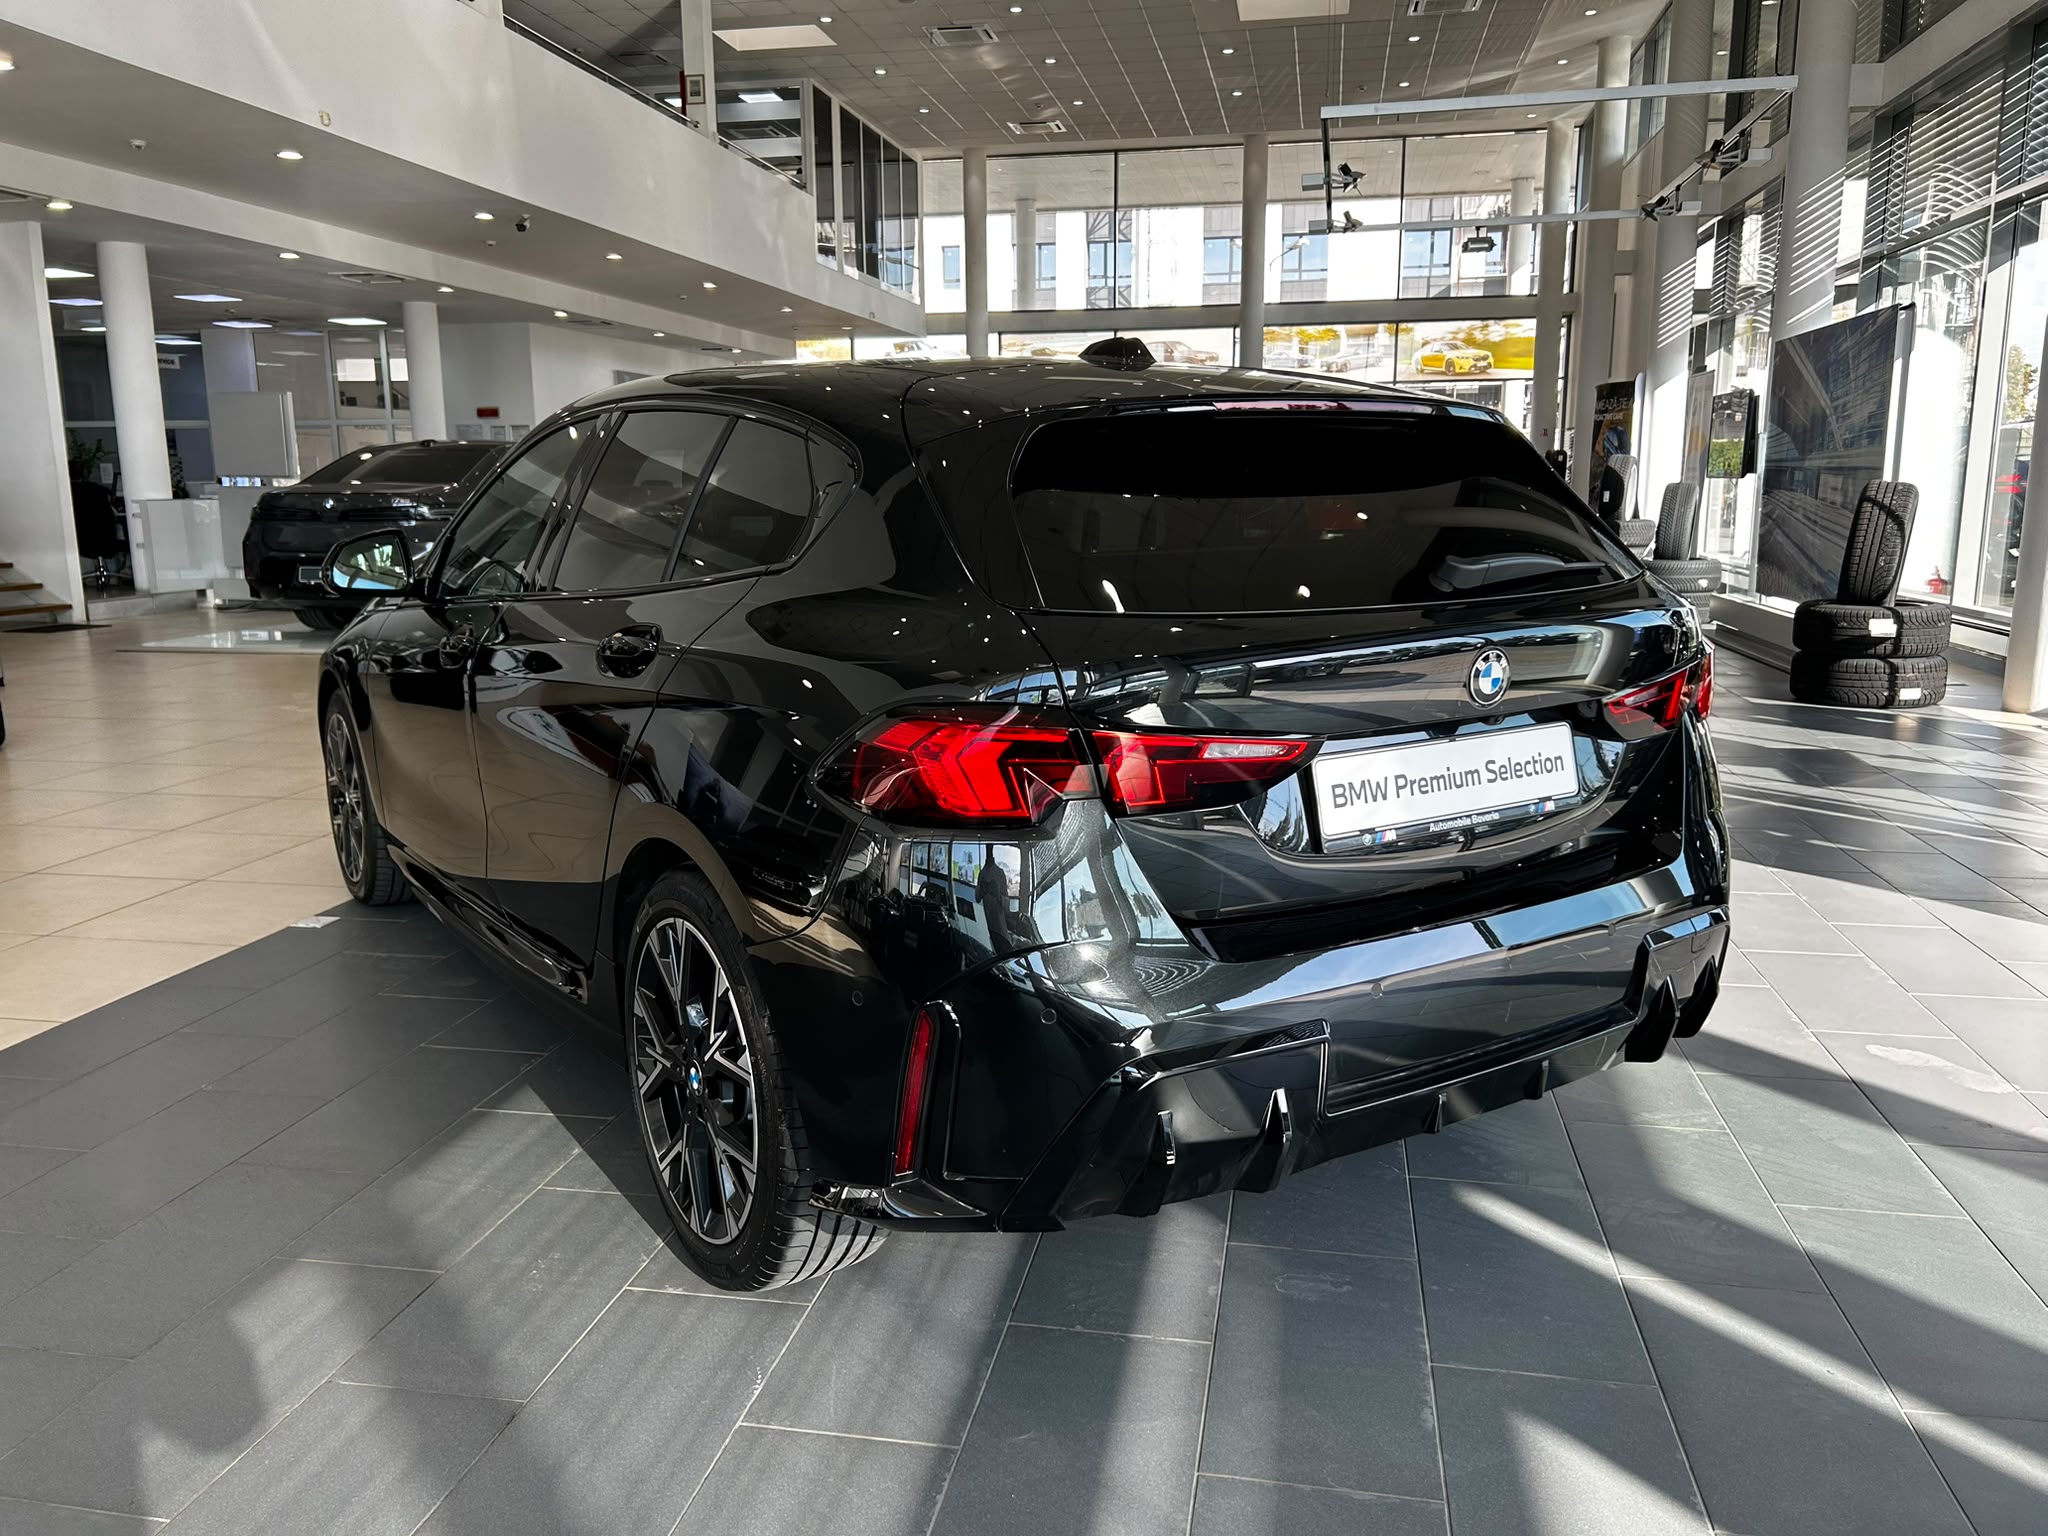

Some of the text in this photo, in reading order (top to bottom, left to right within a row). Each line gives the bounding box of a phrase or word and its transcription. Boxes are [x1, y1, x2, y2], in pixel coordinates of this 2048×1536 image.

[1331, 752, 1565, 809] BMW Premium Selection
[1429, 811, 1500, 833] Automobile Bavaria
